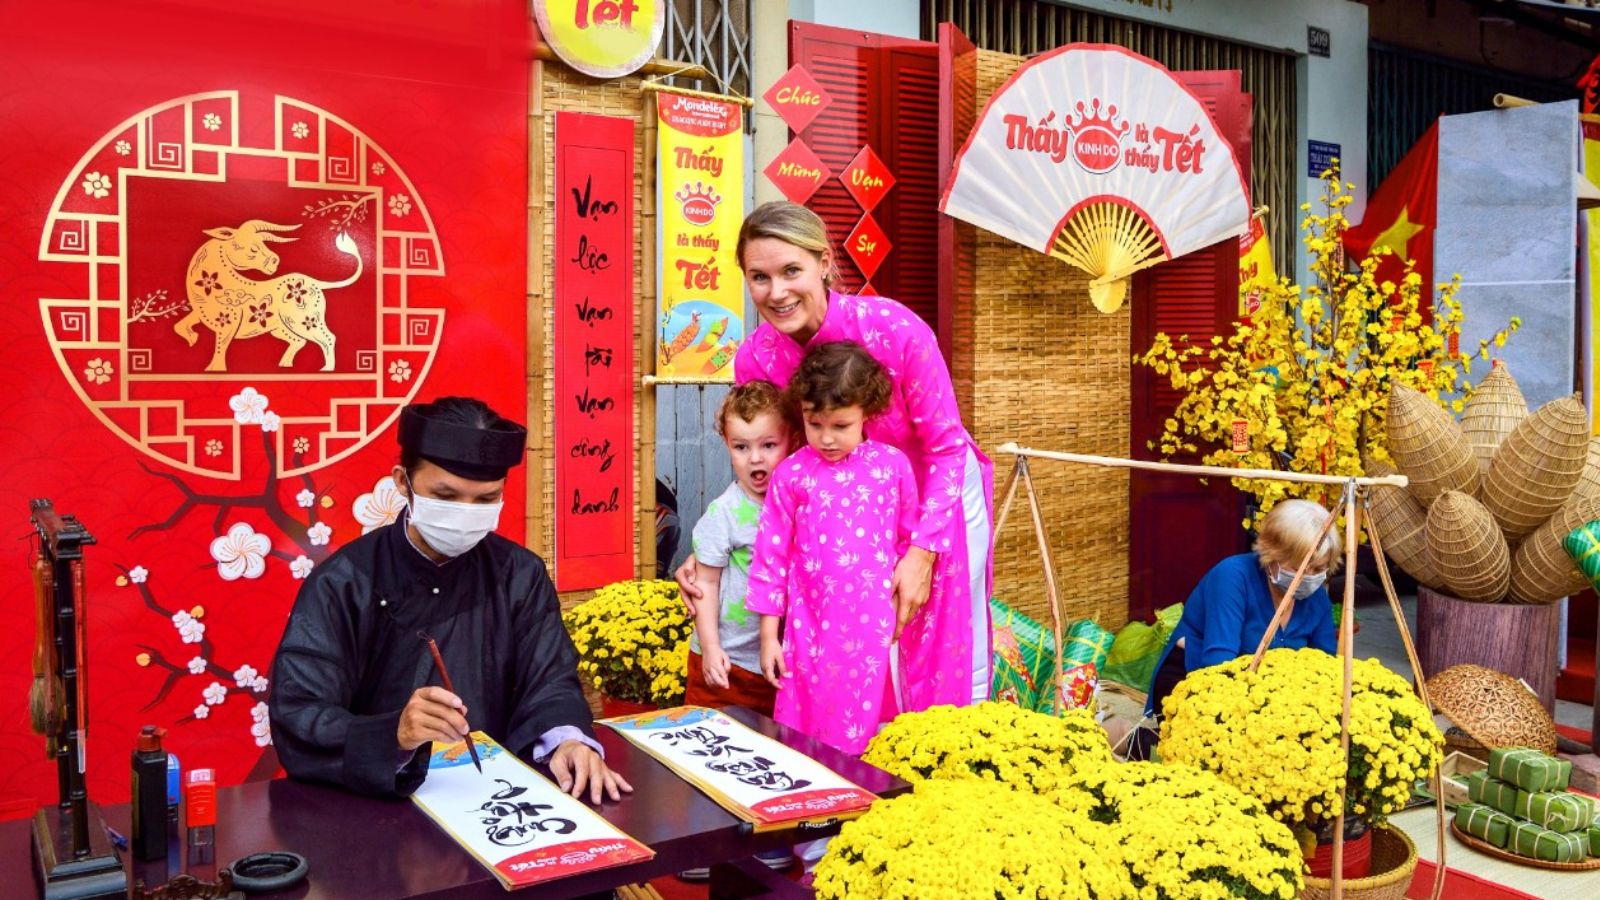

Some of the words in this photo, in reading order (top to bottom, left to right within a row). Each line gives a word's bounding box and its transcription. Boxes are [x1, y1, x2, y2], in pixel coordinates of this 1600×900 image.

[776, 86, 821, 106] Chúc
[1003, 110, 1069, 163] Thấy
[1135, 123, 1149, 143] là
[1078, 142, 1102, 155] KINH
[1124, 144, 1160, 174] thấy
[1152, 123, 1206, 174] Tết
[674, 146, 724, 178] Thấy
[777, 161, 821, 184] Mừng
[852, 168, 884, 191] Vạn
[571, 174, 618, 222] Vạn
[677, 233, 689, 247] là
[692, 232, 720, 252] thấy
[856, 234, 876, 256] Sự
[675, 256, 721, 290] Tết
